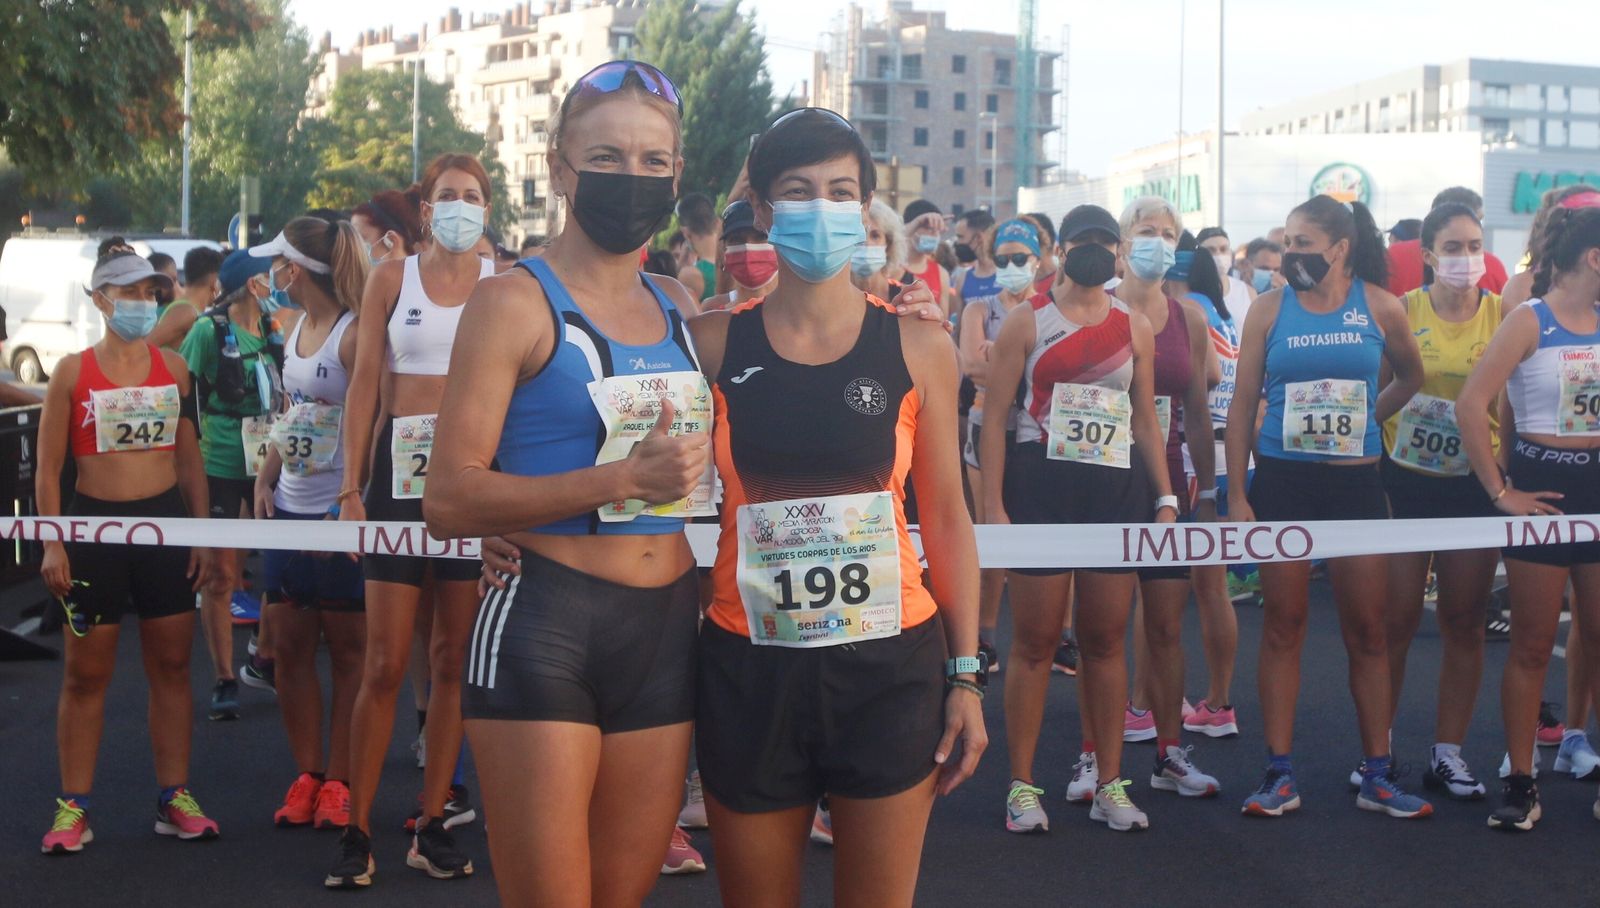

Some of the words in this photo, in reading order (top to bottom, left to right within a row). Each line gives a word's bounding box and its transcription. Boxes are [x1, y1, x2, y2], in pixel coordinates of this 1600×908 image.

[1343, 307, 1369, 326] als
[1043, 330, 1066, 346] Joma
[1287, 332, 1363, 349] TROTASIERRA
[636, 378, 669, 392] XXXV
[116, 421, 165, 445] 242
[623, 423, 644, 431] RAQUEL
[1067, 419, 1117, 446] 307
[1302, 413, 1352, 436] 118
[285, 435, 313, 458] 33
[1410, 426, 1462, 458] 508
[412, 453, 428, 477] 2
[1541, 449, 1591, 465] PRO
[784, 503, 826, 520] XXXV
[754, 535, 774, 545] VAR
[1122, 525, 1314, 563] IMDECO
[760, 551, 795, 563] VIRTUDES
[797, 549, 829, 559] CORPAS
[830, 547, 840, 556] DE
[842, 546, 858, 555] LOS
[859, 543, 877, 553] RIOS
[774, 562, 871, 611] 198
[868, 607, 895, 616] IMDECO
[797, 617, 852, 631] serizona
